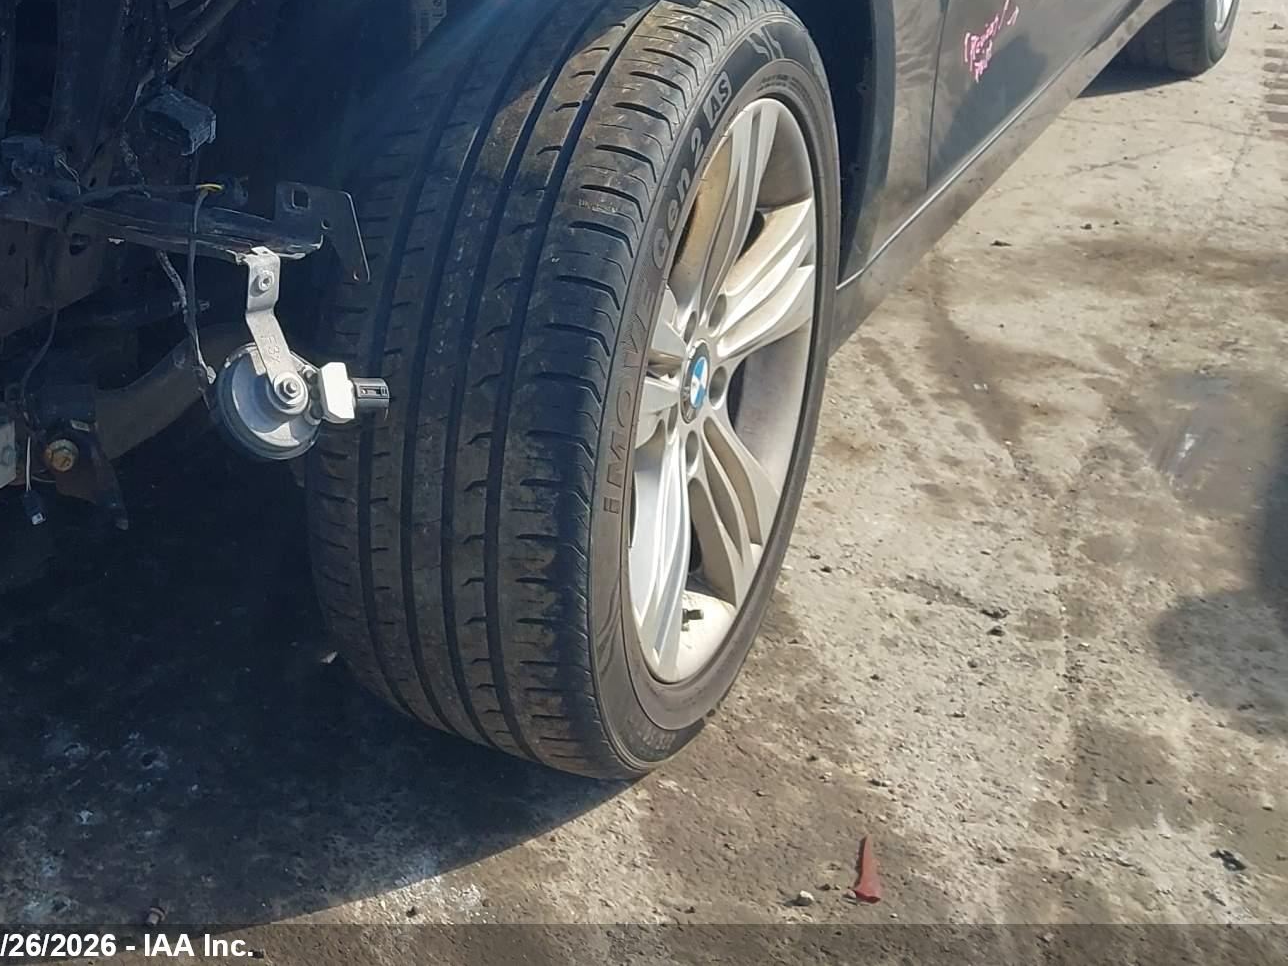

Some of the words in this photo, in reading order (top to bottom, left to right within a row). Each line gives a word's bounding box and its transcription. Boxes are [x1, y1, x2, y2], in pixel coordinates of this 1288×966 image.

[652, 167, 691, 269] Gen
[691, 126, 706, 168] 2
[709, 78, 731, 122] AS
